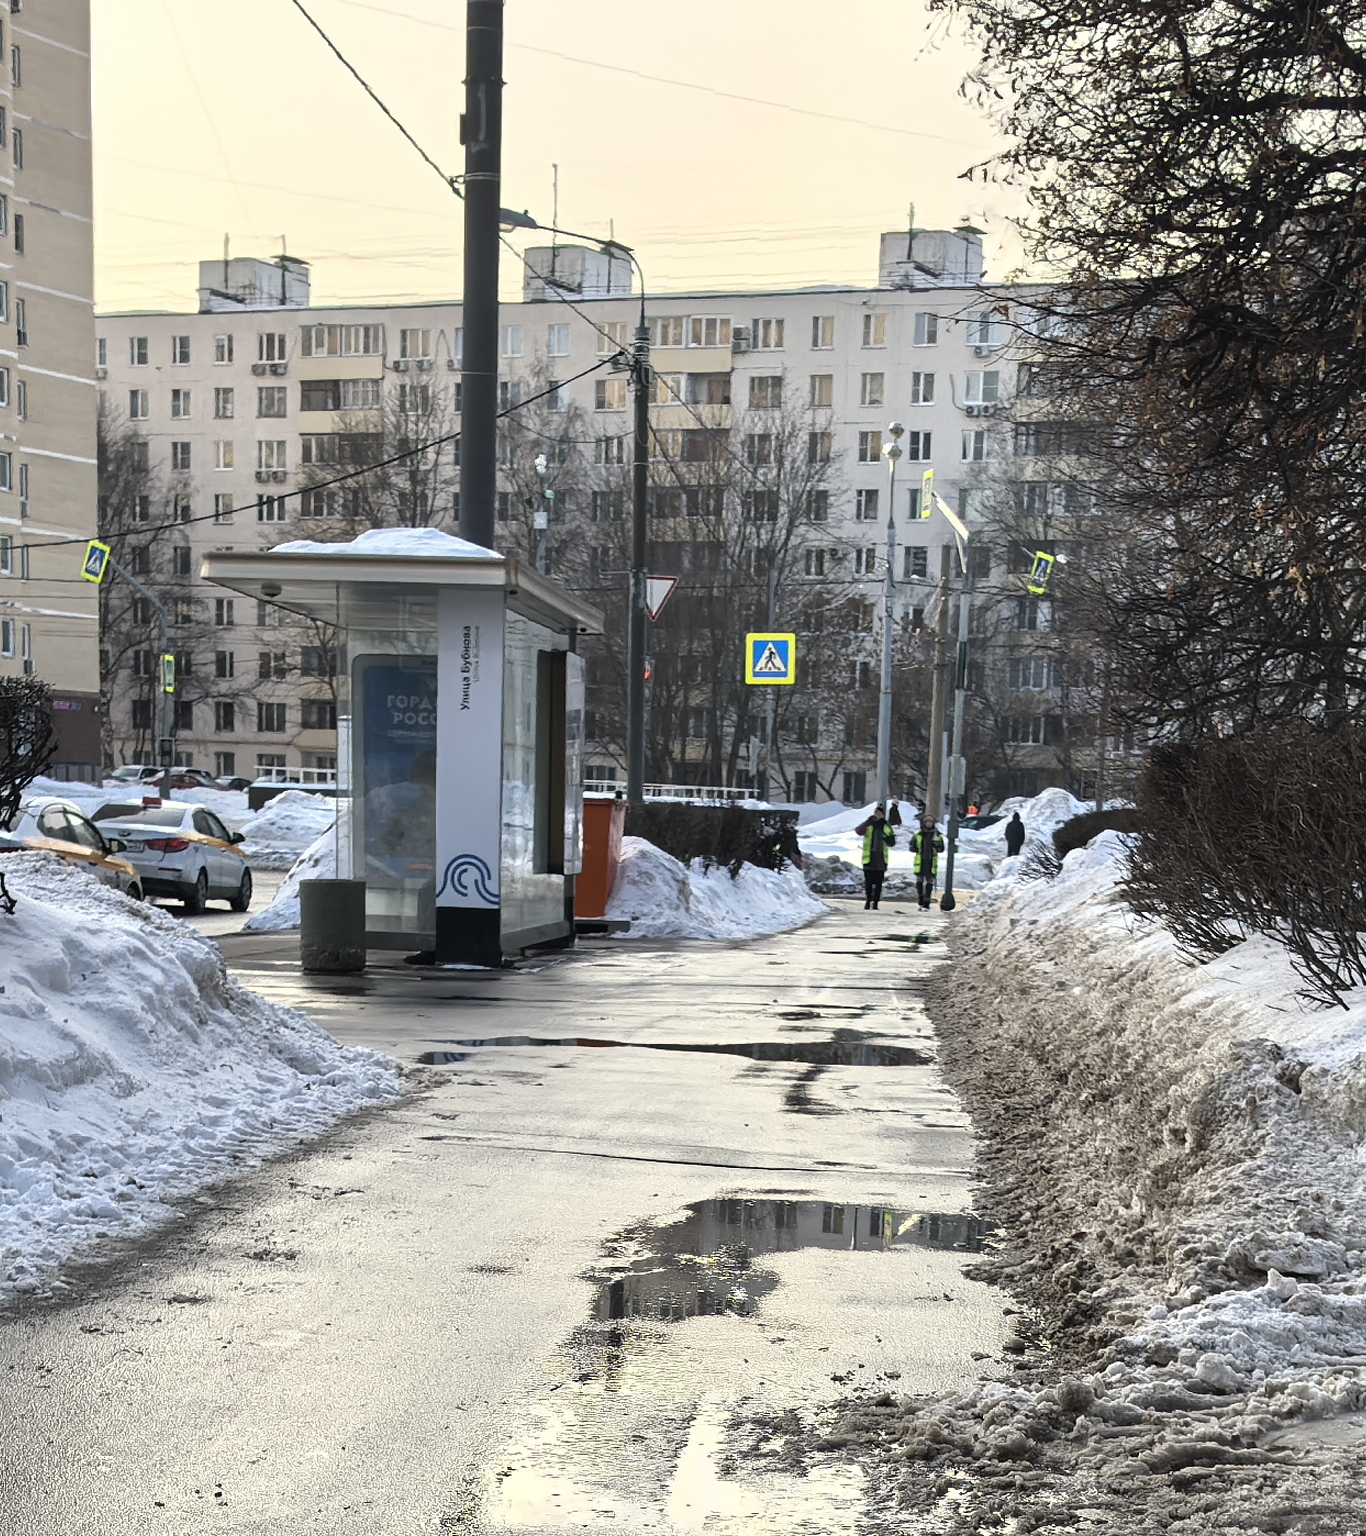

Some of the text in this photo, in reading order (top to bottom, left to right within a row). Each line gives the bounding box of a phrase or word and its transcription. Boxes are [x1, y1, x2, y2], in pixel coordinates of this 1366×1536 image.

[460, 625, 472, 711] Улица Бубнова
[387, 694, 437, 710] ГОРД
